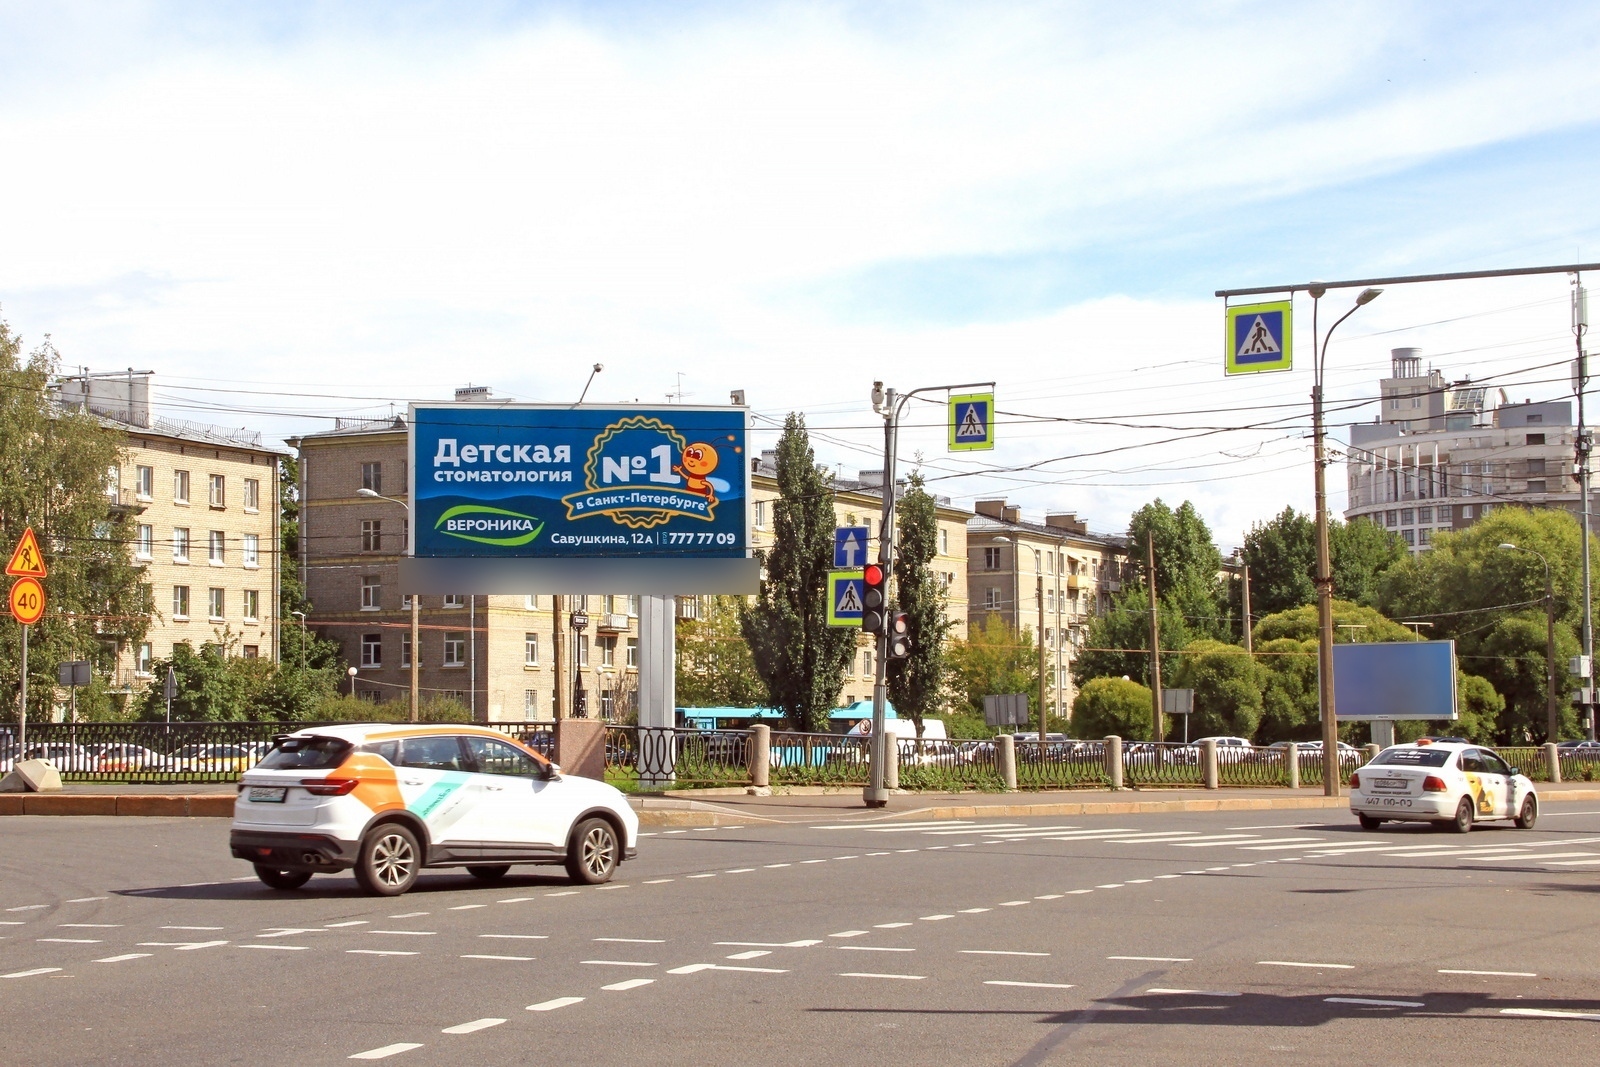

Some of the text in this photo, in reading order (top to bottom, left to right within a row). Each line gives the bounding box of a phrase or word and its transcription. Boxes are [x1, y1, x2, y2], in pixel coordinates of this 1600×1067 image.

[433, 438, 571, 467] Детская
[433, 470, 573, 482] стоматология
[575, 501, 584, 510] в
[447, 519, 534, 531] ВЕРОНИКА
[550, 533, 629, 546] Савушкина,
[669, 532, 695, 545] 777
[697, 532, 714, 545] 77
[716, 532, 736, 545] 09
[17, 592, 37, 610] 40
